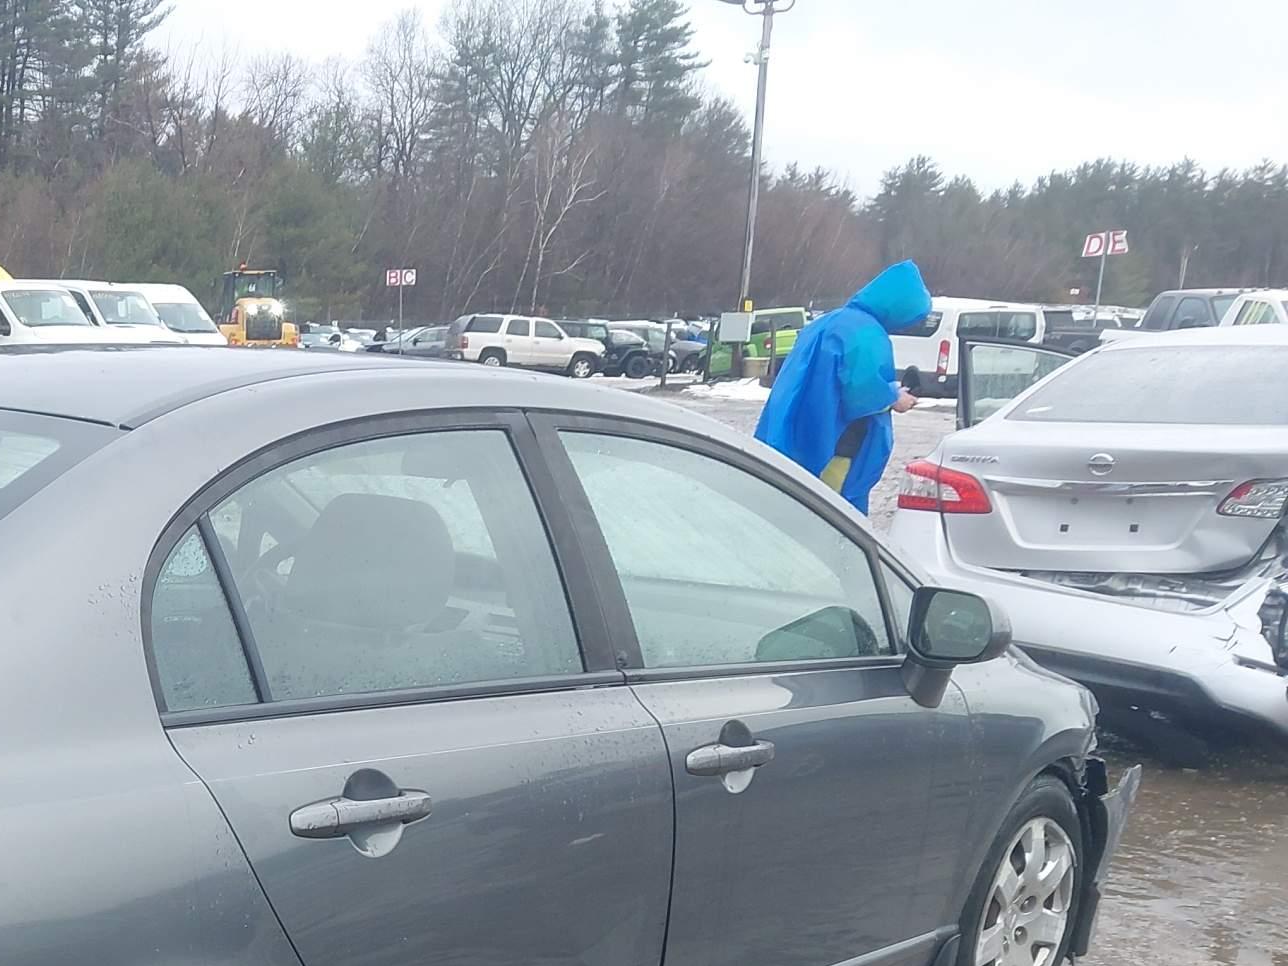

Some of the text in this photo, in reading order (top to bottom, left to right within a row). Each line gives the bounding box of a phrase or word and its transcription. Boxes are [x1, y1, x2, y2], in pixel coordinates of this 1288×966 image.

[1086, 230, 1127, 256] D E
[388, 270, 415, 286] B C
